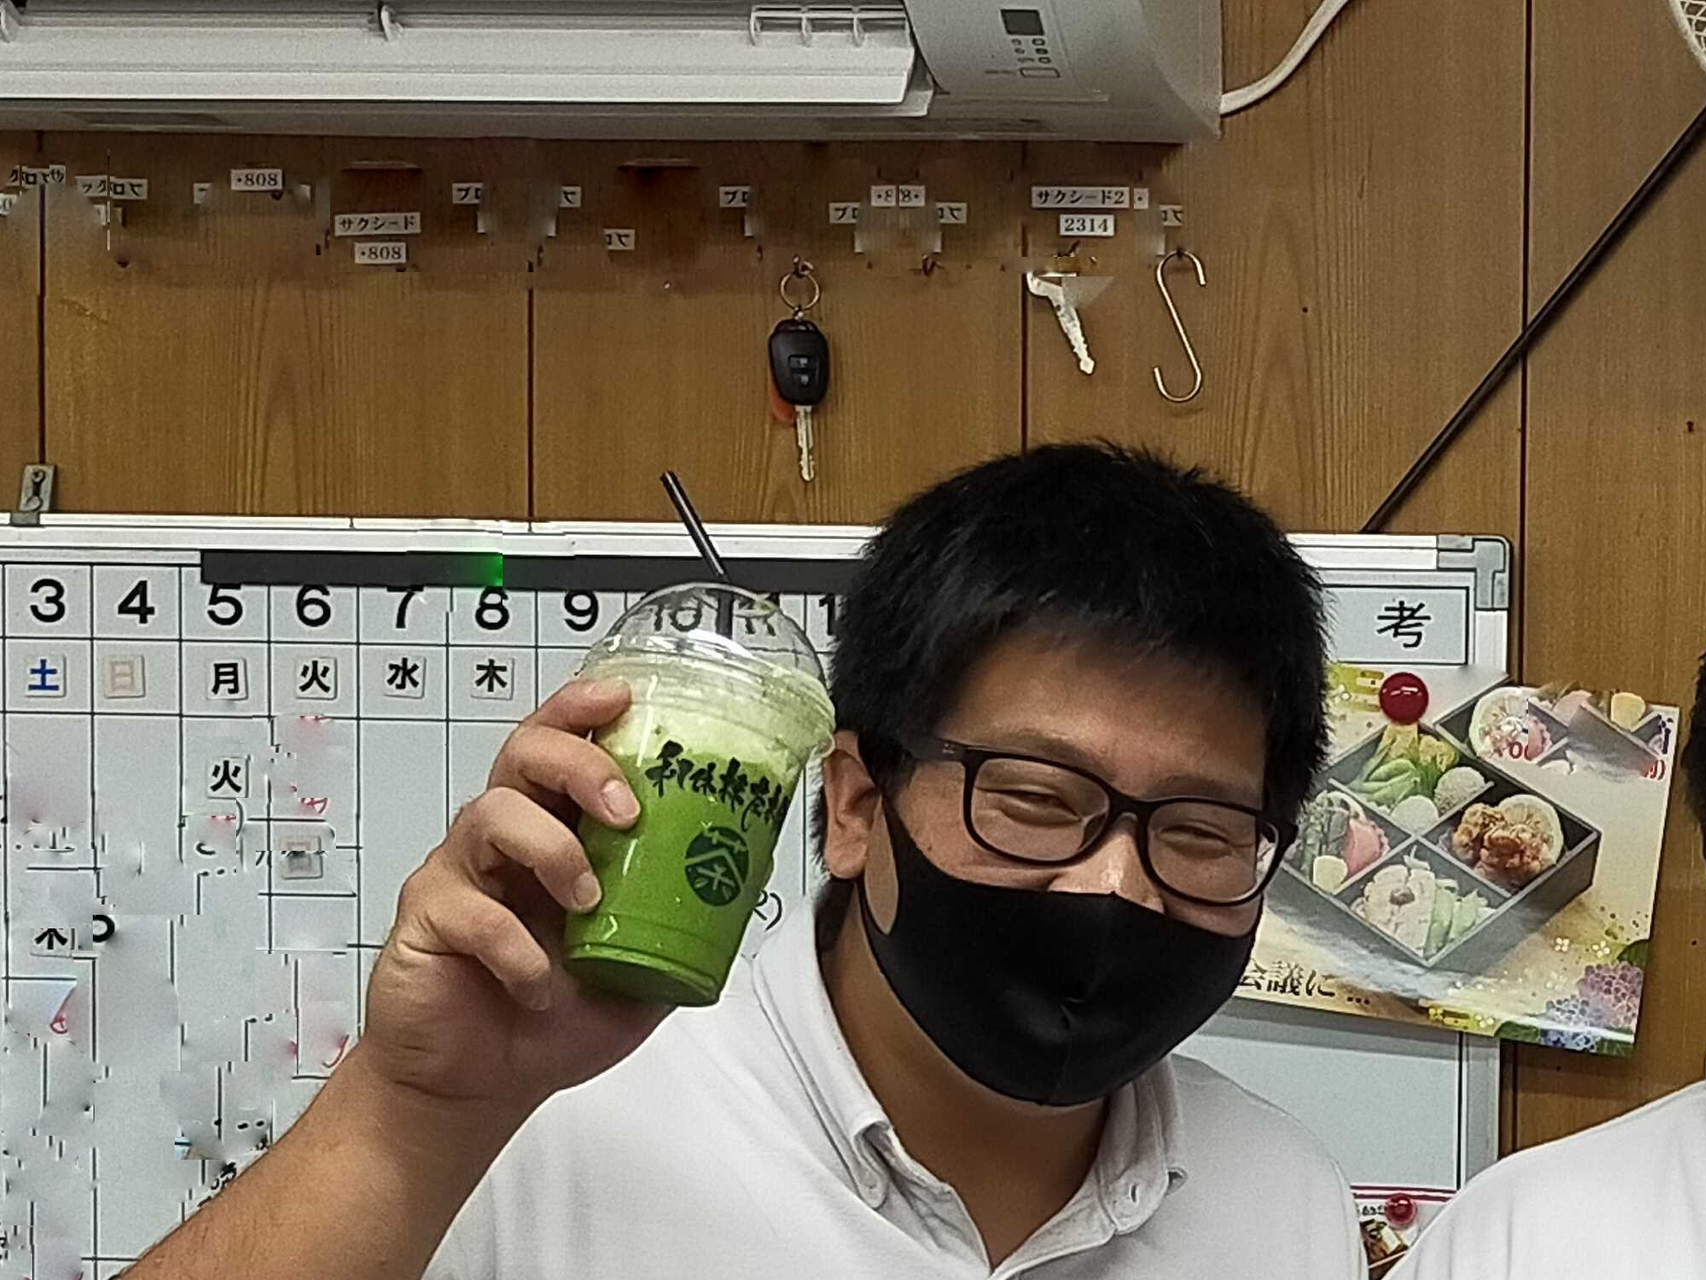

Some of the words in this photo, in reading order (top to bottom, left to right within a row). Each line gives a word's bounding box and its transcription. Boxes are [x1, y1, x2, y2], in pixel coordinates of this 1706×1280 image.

[338, 214, 416, 232] サクシード
[1063, 217, 1109, 233] 2314
[29, 578, 66, 623] 3
[117, 579, 155, 624] 4
[208, 584, 243, 626] 5
[296, 584, 332, 628] 6
[386, 587, 424, 629] 7
[475, 587, 510, 631] 8
[563, 591, 599, 632] 9
[1376, 600, 1432, 649] 考
[30, 659, 59, 691] 土
[110, 660, 137, 691] 日
[213, 662, 240, 693] 月
[300, 661, 332, 693] 火
[387, 659, 421, 690] 水
[474, 660, 508, 689] 木
[210, 759, 244, 793] 火
